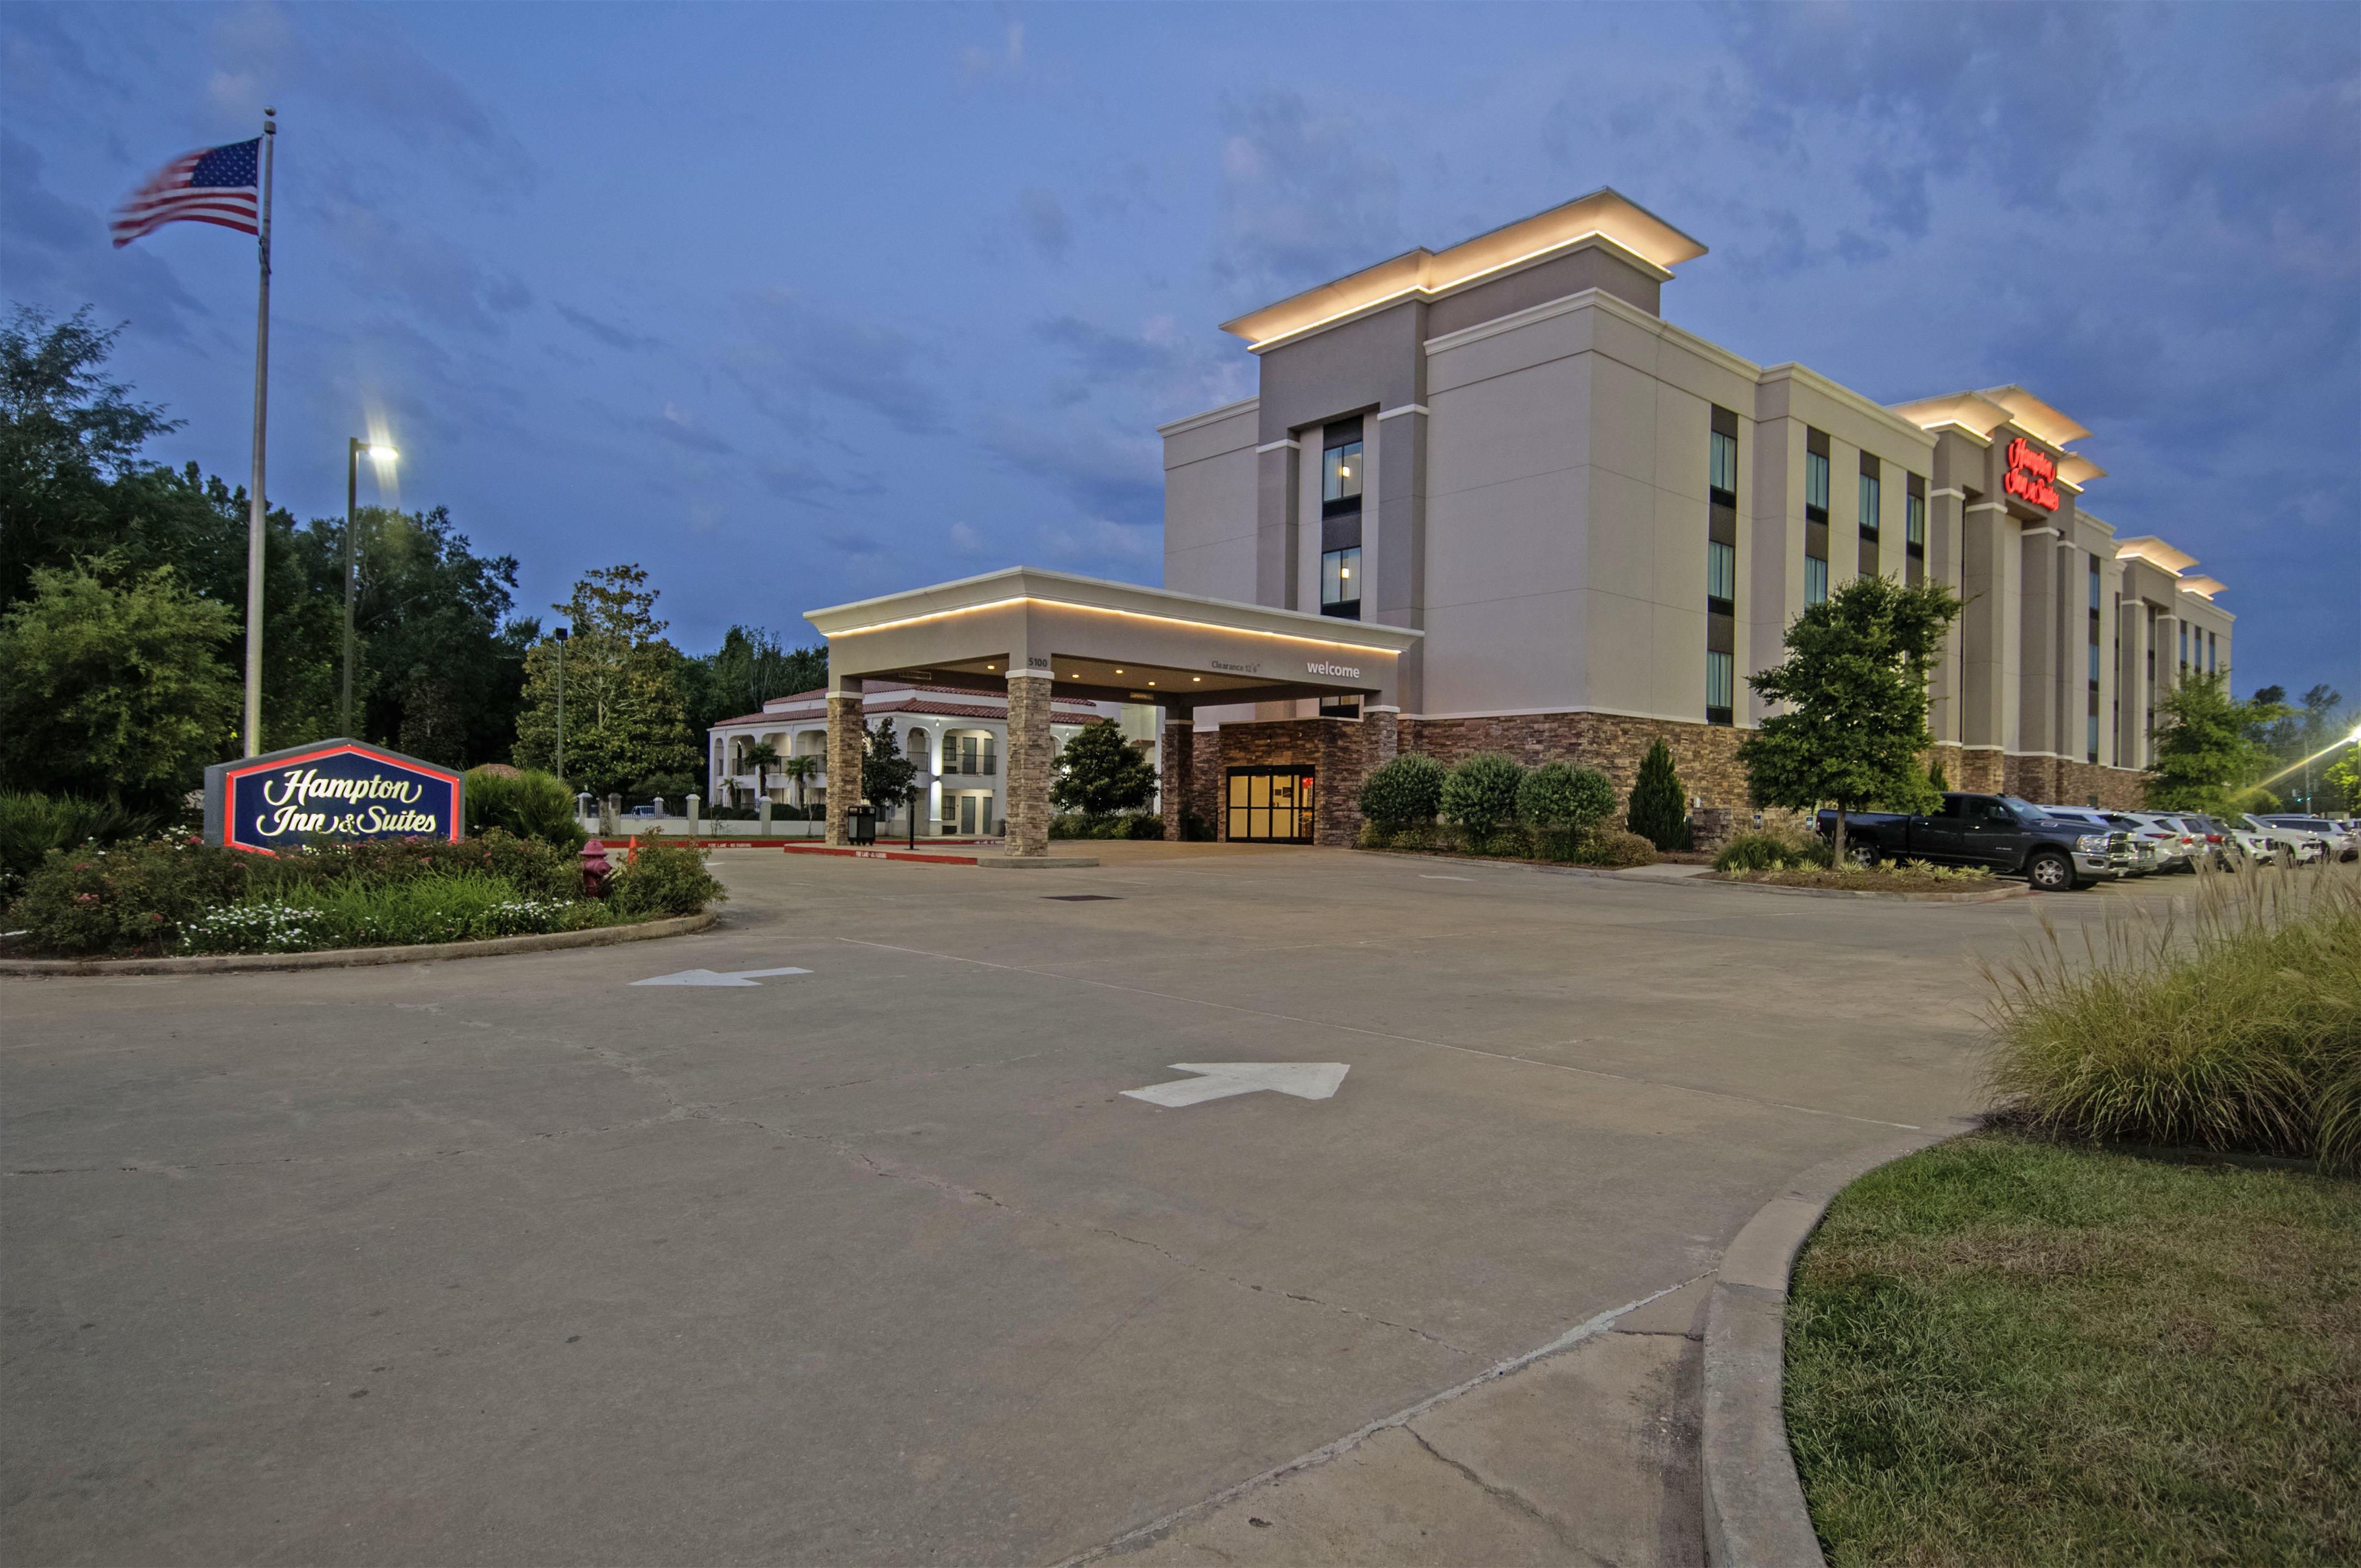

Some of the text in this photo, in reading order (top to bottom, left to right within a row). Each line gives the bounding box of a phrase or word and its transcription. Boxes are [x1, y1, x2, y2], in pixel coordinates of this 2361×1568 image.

[1029, 657, 1048, 667] 5100
[1212, 660, 1244, 671] Clearance
[1307, 661, 1360, 678] welcome
[264, 768, 422, 806] Hampton
[256, 805, 437, 836] Inn & Suites
